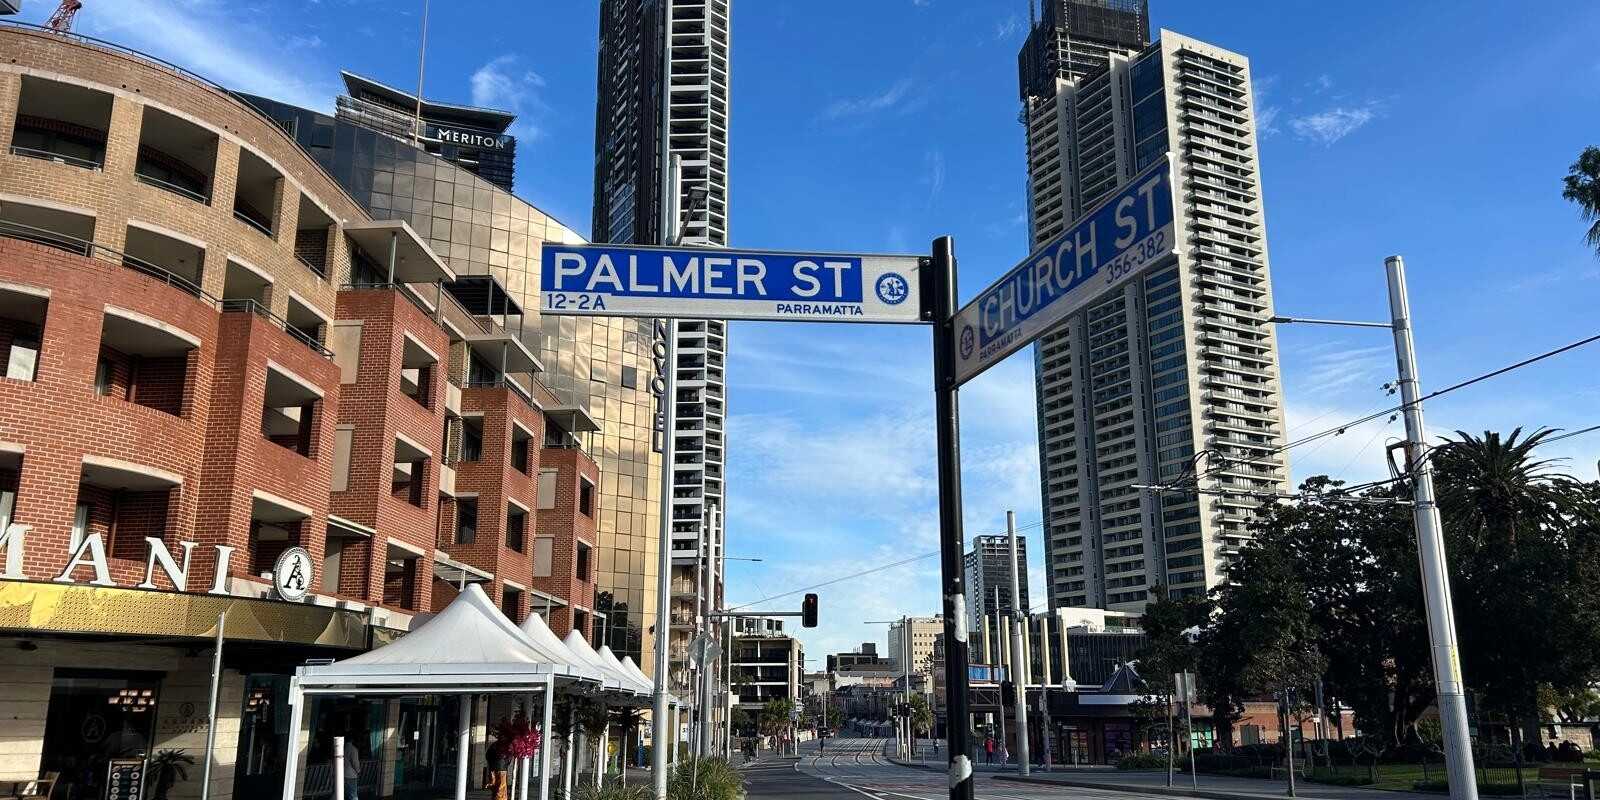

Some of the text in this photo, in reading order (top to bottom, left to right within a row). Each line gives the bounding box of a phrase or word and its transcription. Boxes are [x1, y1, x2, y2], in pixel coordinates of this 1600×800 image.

[438, 129, 504, 148] MERITON
[554, 253, 767, 295] PALMER
[790, 260, 852, 298] ST
[983, 175, 1161, 337] CHURCH ST
[1105, 231, 1165, 285] 356-382
[547, 293, 606, 311] 12-2A
[776, 303, 864, 316] PARRAMATTA
[652, 318, 666, 453] NOVOTEL
